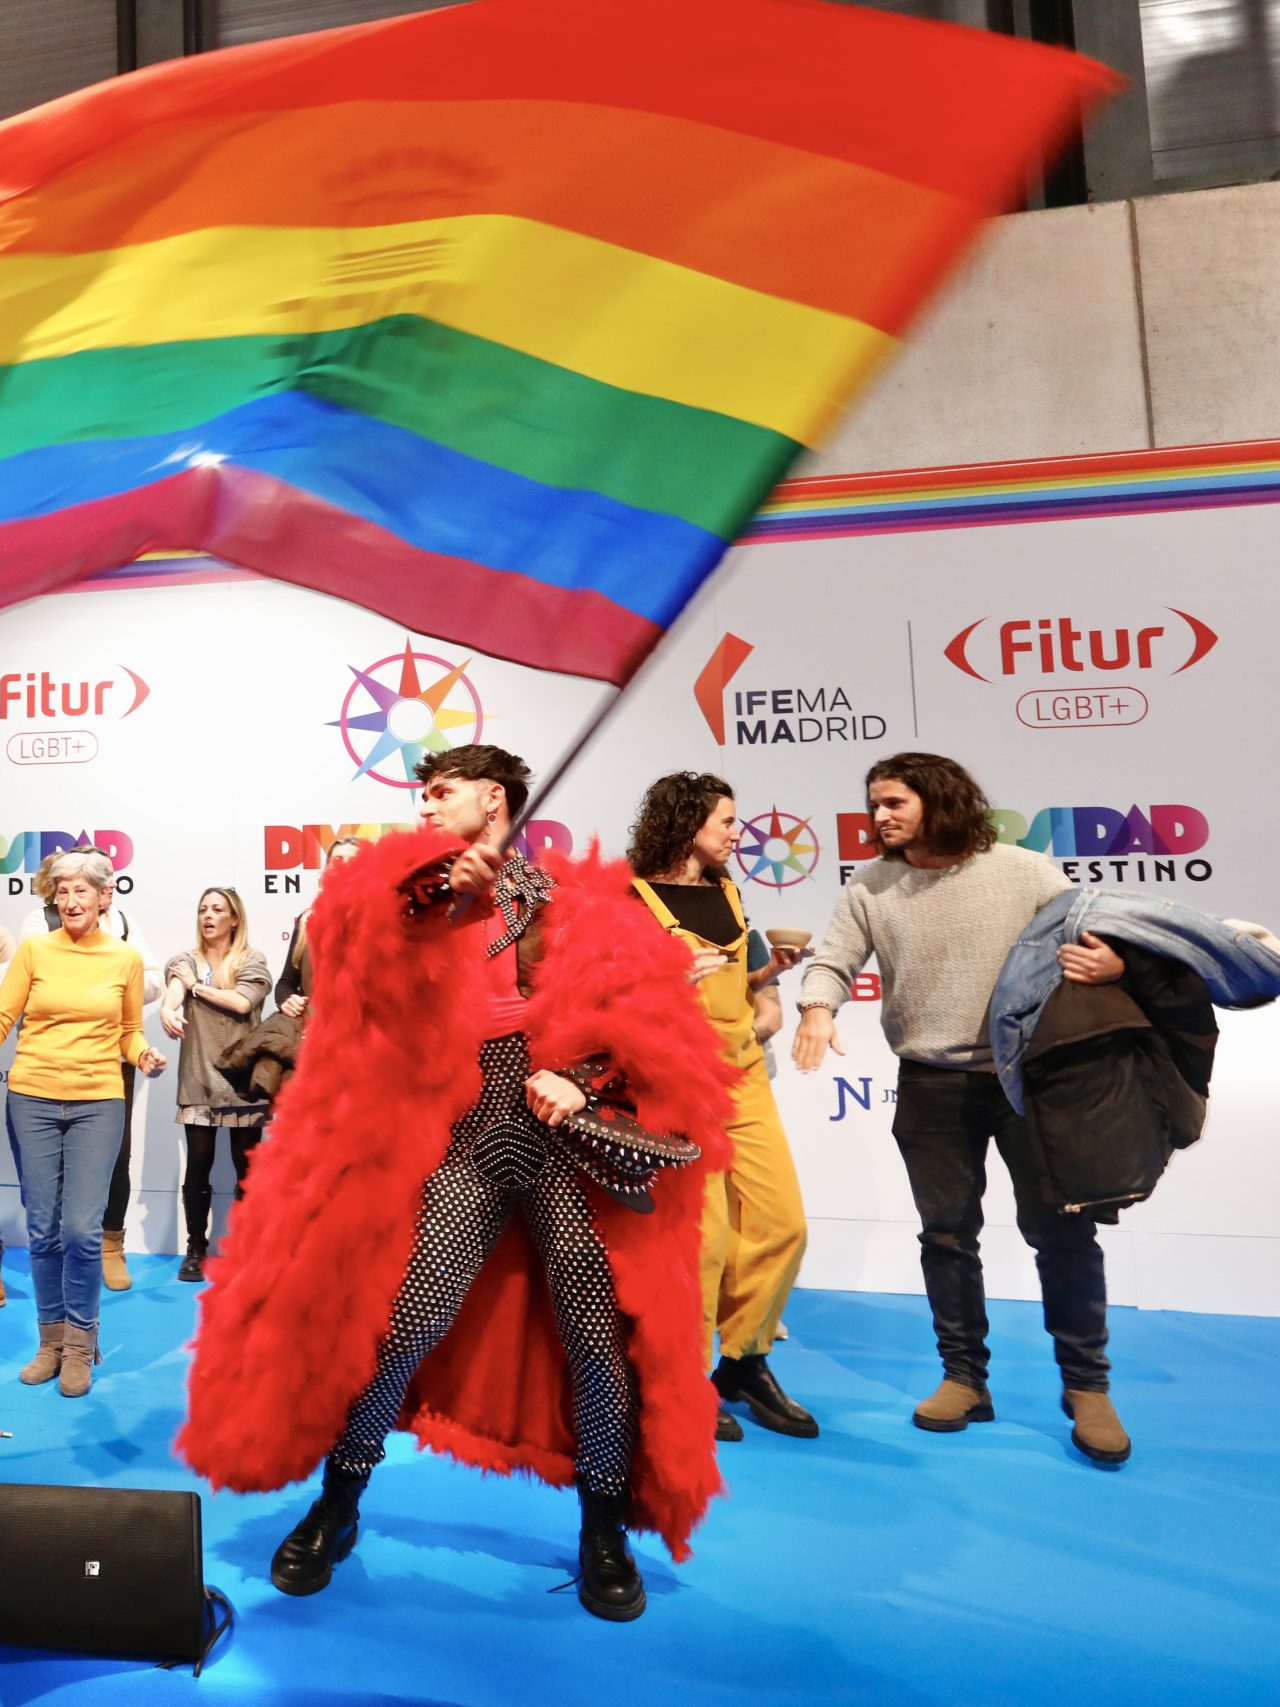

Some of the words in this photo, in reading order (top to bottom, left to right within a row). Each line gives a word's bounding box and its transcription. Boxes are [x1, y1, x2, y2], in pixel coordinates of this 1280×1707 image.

[1000, 617, 1165, 675] Fitur
[0, 671, 114, 719] Fitur
[735, 687, 852, 716] IFEMA
[1035, 694, 1130, 721] LGBT+
[737, 715, 887, 745] MADRID
[19, 737, 86, 760] LGBT+
[1063, 859, 1212, 883] ESTINO
